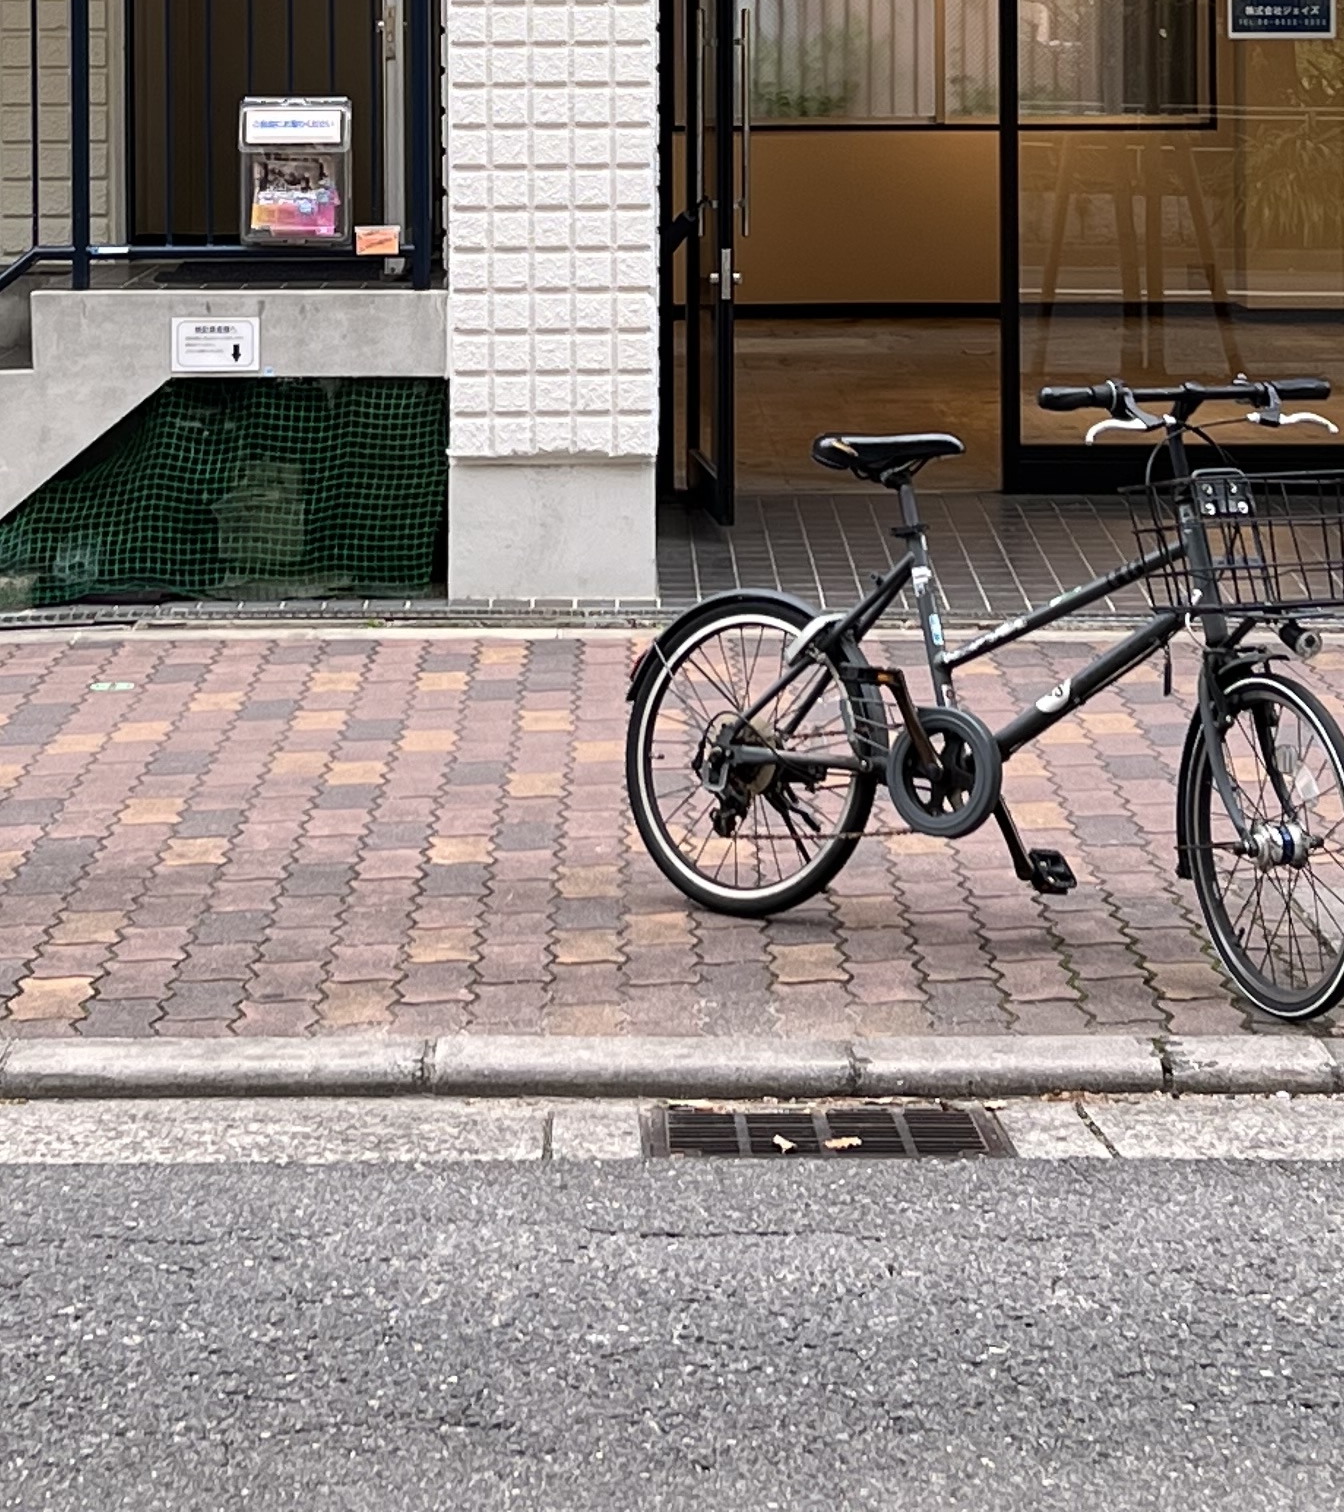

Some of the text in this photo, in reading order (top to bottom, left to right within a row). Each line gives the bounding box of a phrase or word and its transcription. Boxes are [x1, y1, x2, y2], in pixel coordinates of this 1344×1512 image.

[1244, 5, 1321, 17] 株式会社ジェイズ
